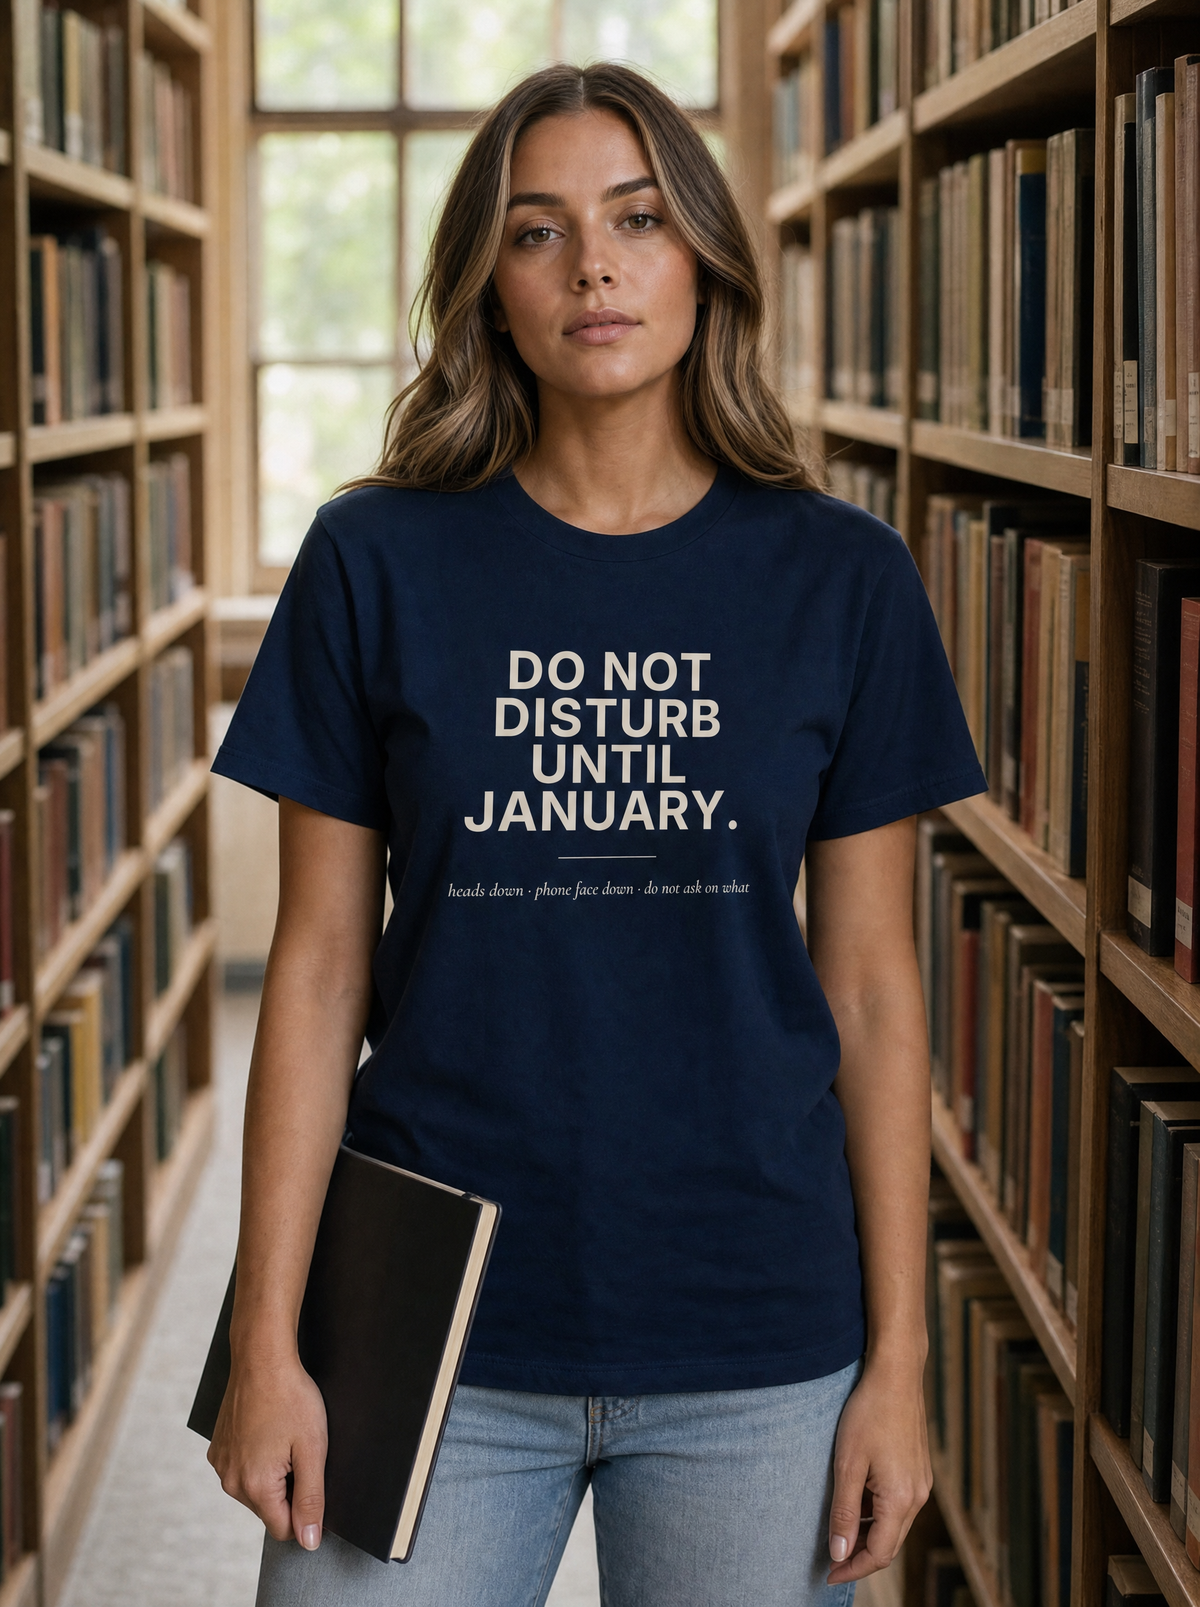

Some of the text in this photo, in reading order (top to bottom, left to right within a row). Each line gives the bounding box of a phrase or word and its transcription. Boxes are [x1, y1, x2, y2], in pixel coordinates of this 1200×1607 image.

[510, 650, 711, 692] DO NOT
[495, 697, 721, 739] DISTURB
[532, 743, 686, 785] UNTIL
[464, 790, 738, 833] JANUARY.
[447, 879, 750, 901] heads down phone face down do not ask on what
